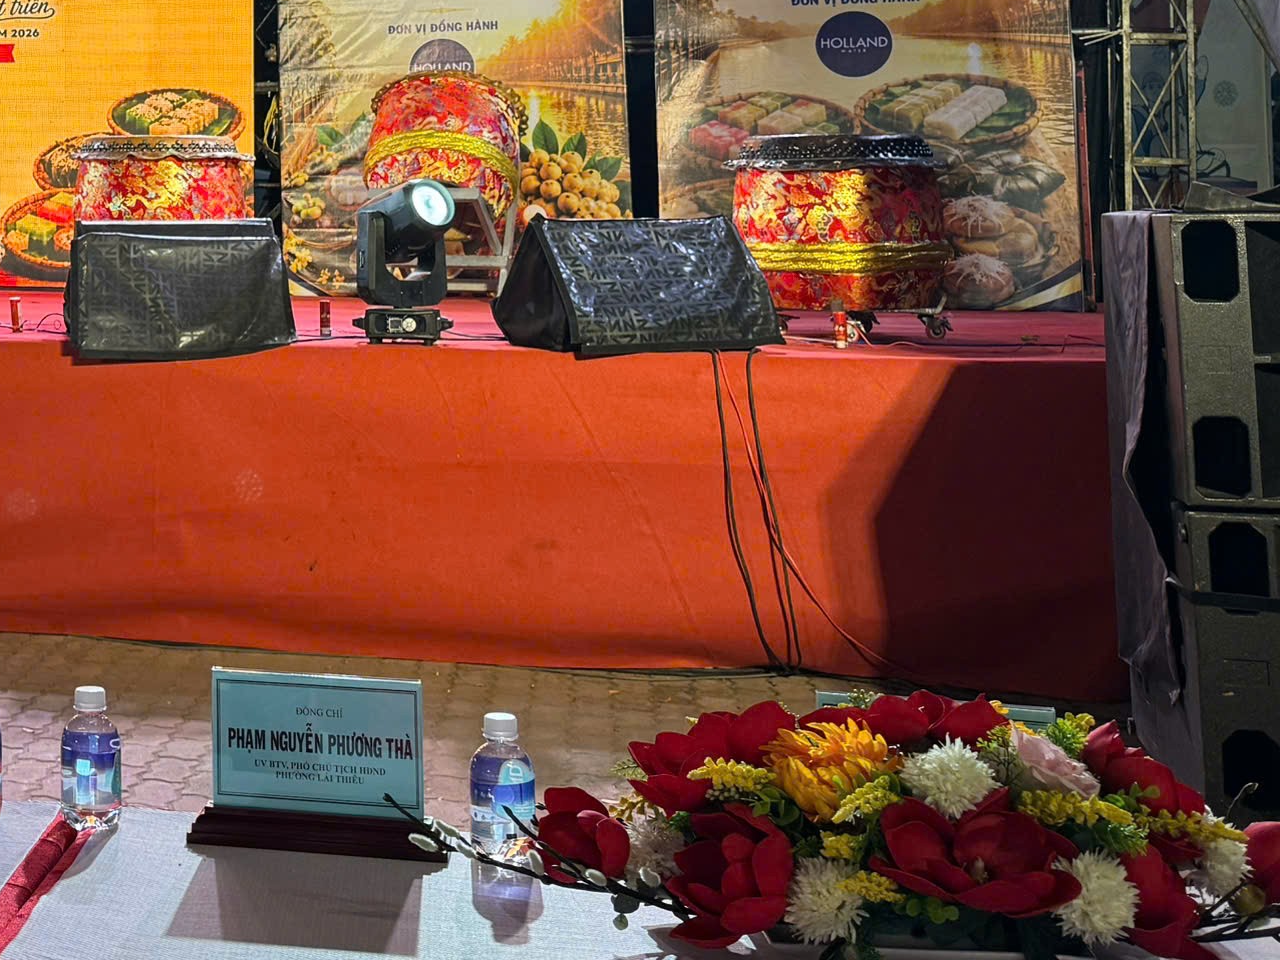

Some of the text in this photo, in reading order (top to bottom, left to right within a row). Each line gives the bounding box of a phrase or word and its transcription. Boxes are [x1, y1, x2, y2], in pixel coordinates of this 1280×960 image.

[12, 28, 39, 38] 2026
[821, 37, 887, 49] HOLLAND
[228, 728, 265, 753] PHẠM
[271, 723, 323, 754] NGUYỄN
[328, 732, 382, 758] PHƯƠNG
